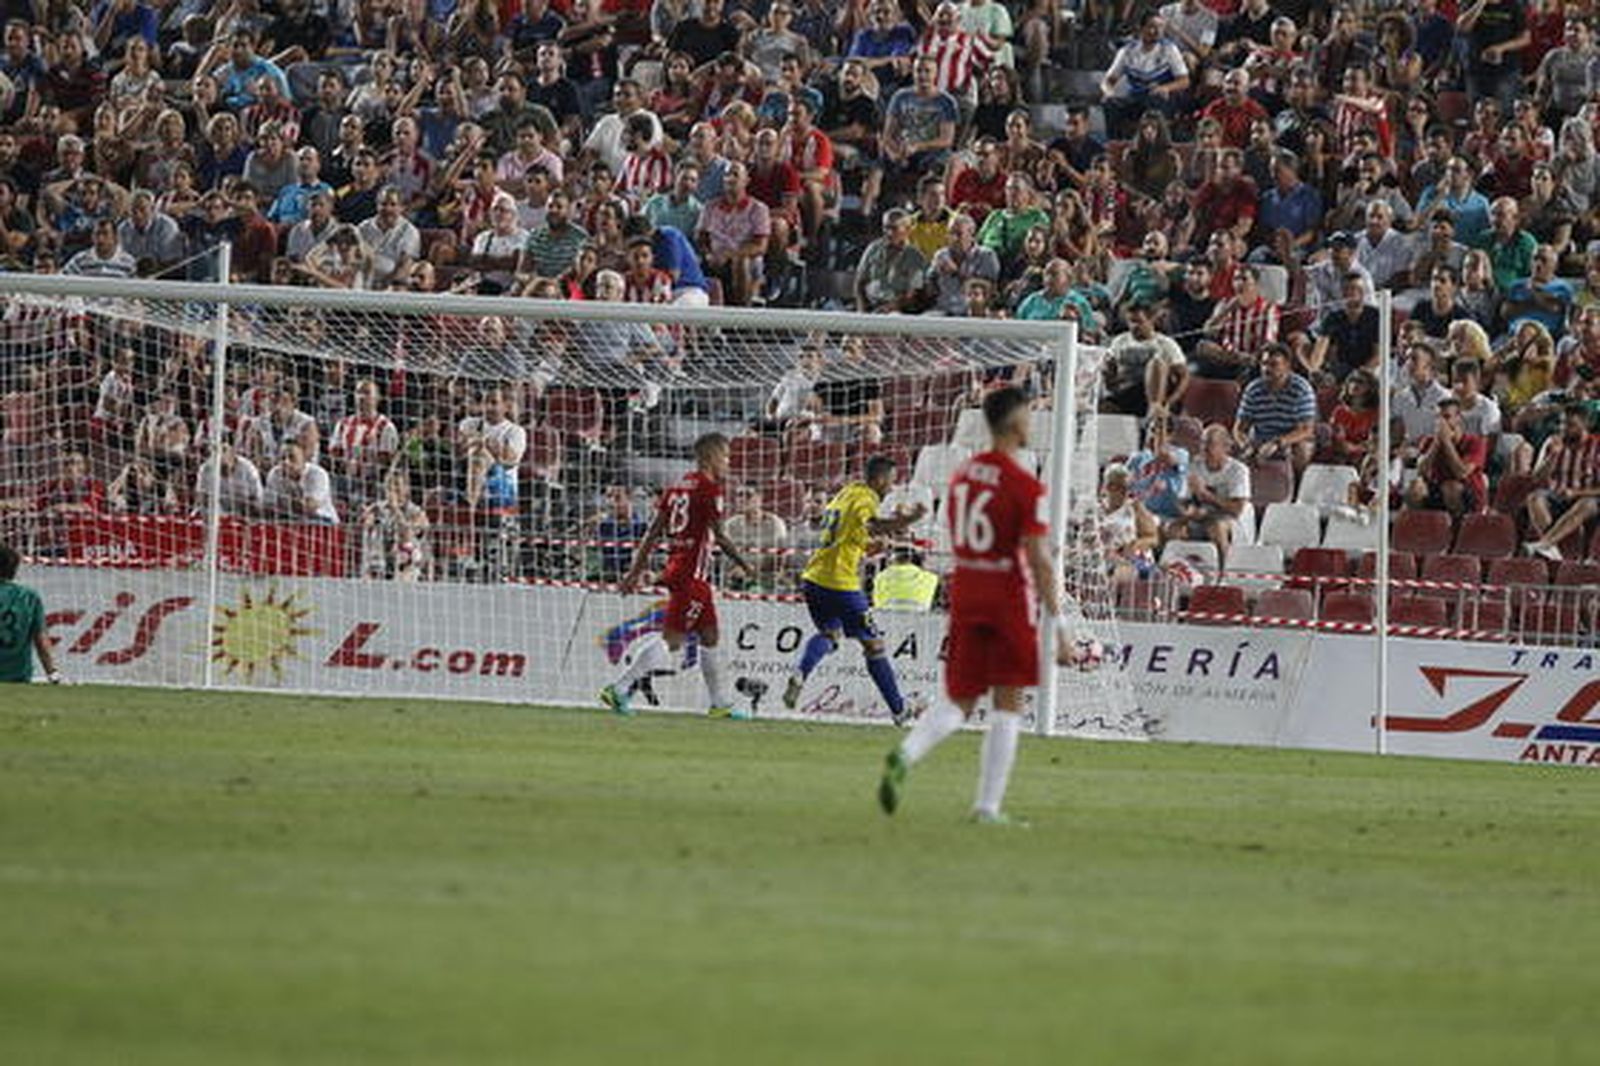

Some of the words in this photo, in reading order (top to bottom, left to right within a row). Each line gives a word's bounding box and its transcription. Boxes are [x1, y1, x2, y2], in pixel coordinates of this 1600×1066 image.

[954, 483, 995, 553] 16
[737, 622, 919, 661] COA
[1100, 641, 1280, 681] MERÍA
[1510, 651, 1594, 671] TRA
